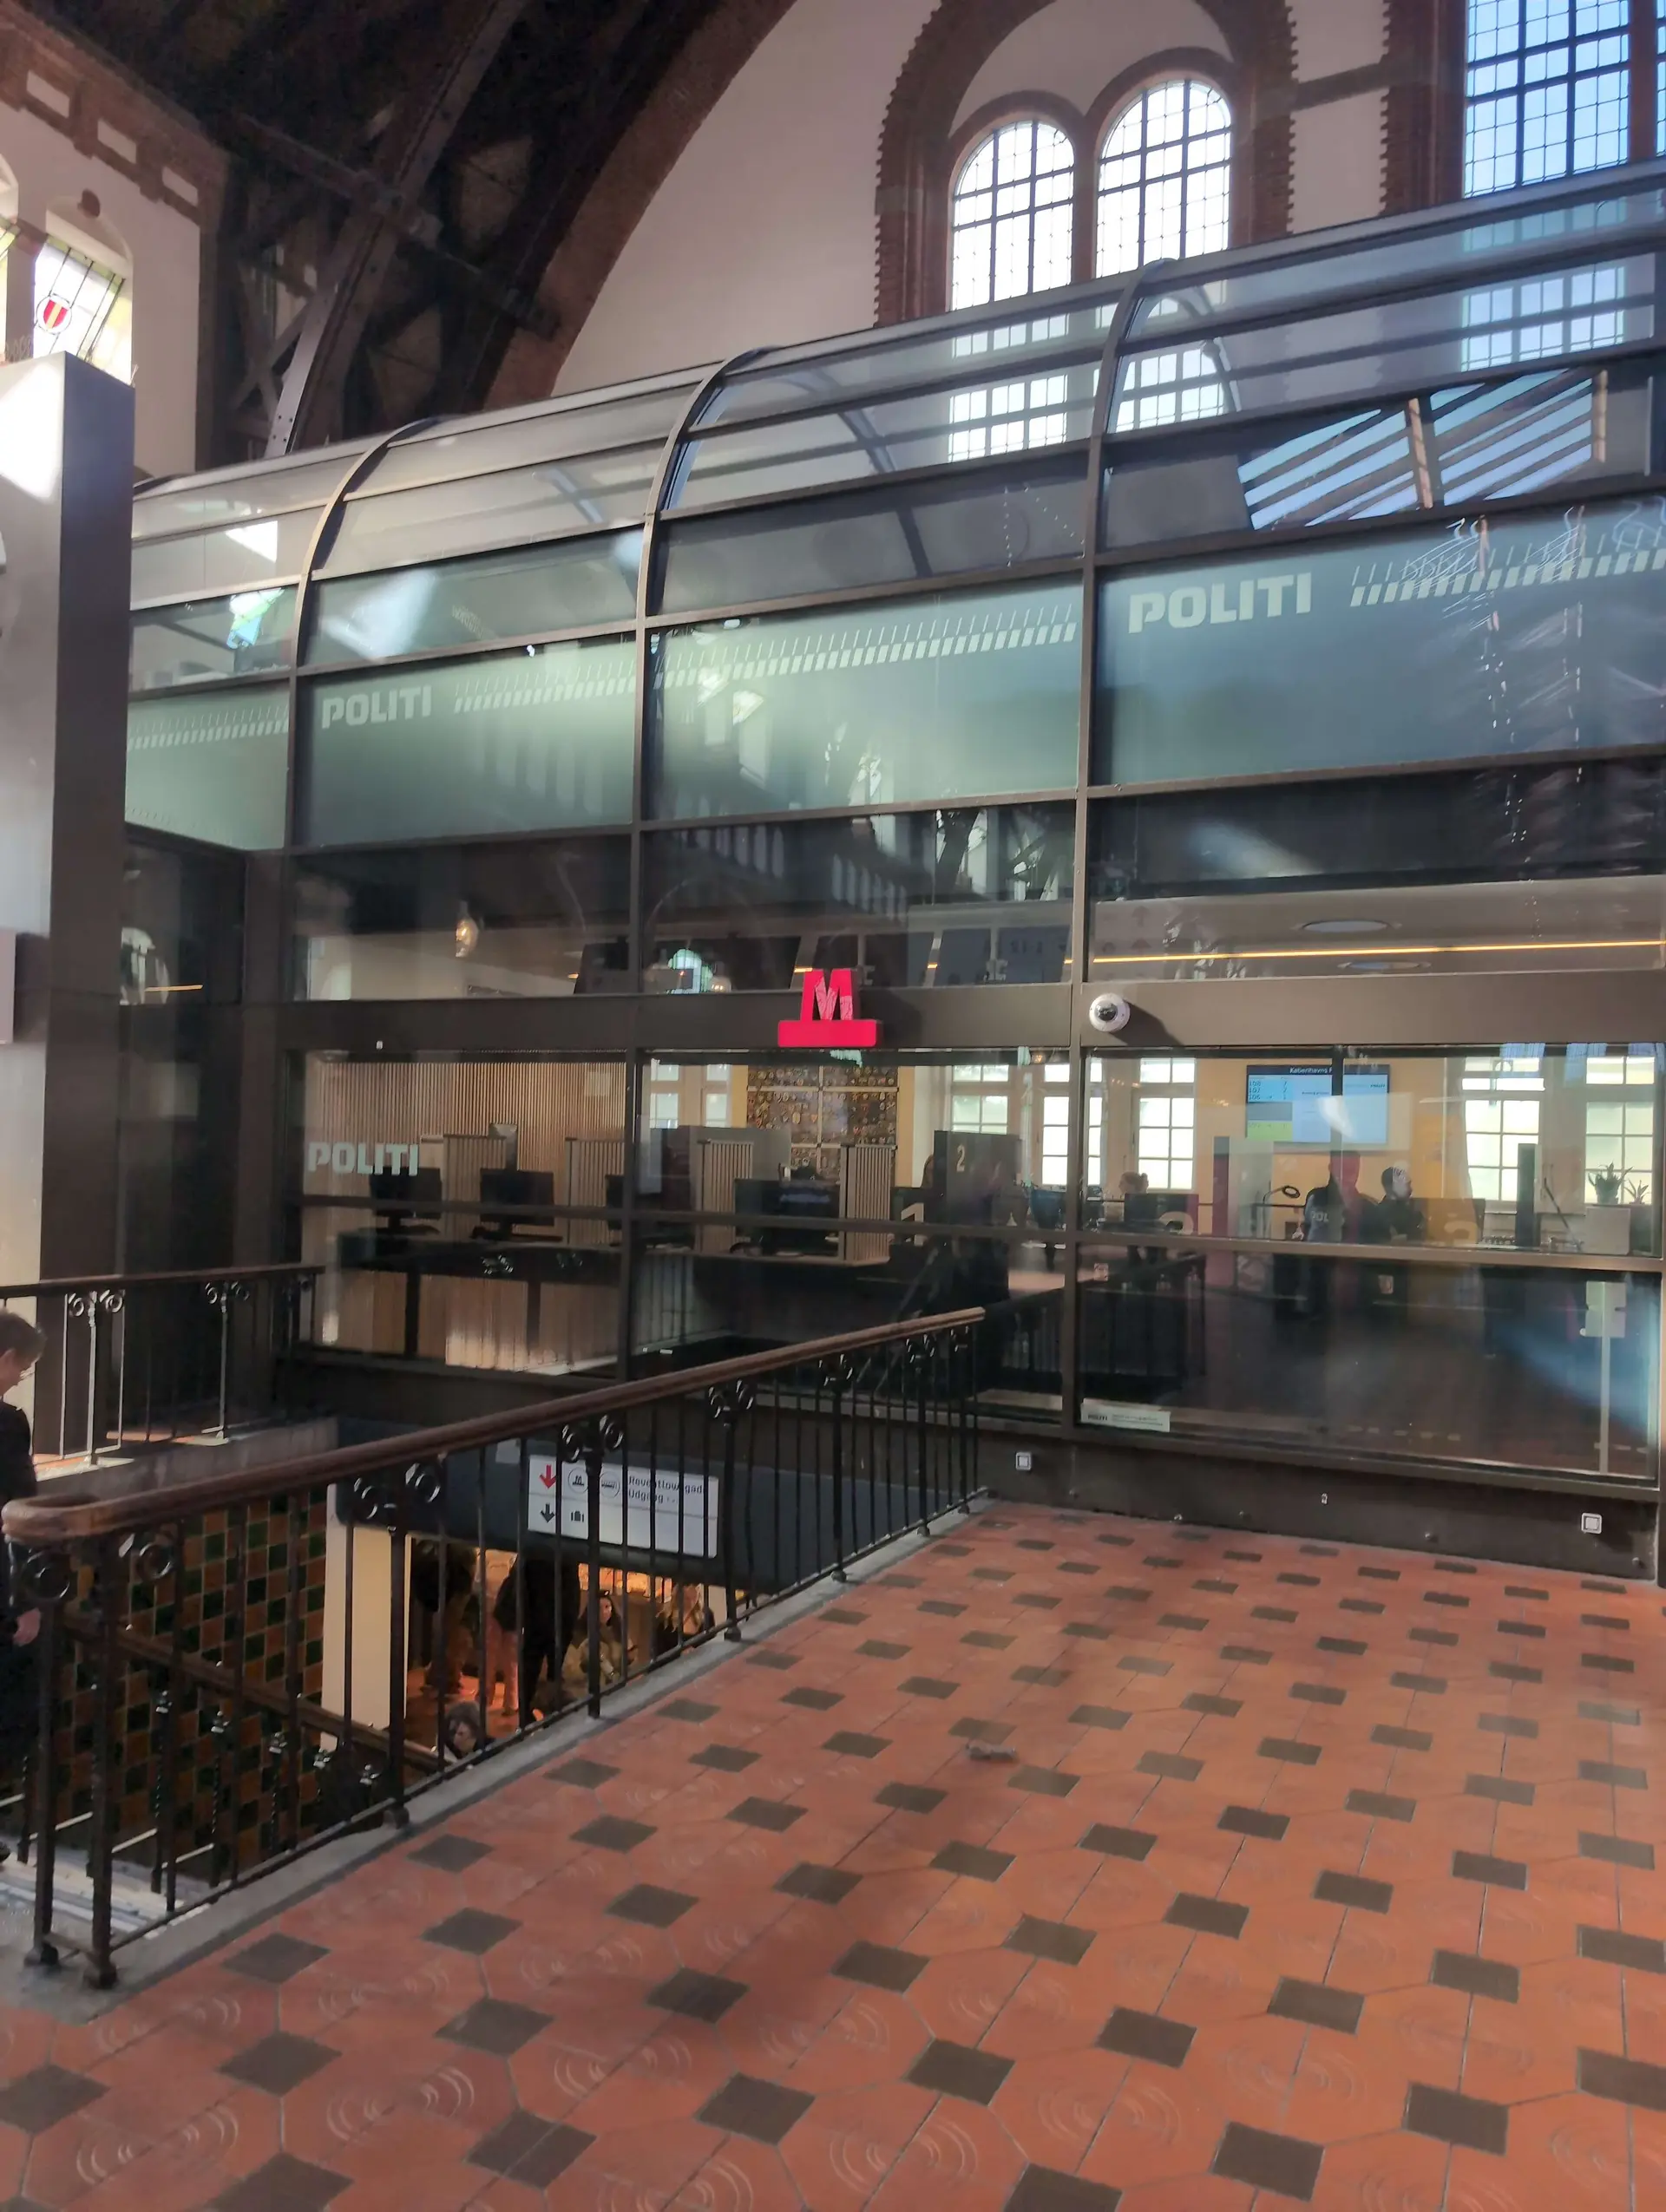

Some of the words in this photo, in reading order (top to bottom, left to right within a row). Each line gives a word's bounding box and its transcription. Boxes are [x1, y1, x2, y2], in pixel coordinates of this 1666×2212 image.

[1128, 572, 1312, 634] POLITI
[322, 684, 432, 729] POLITI
[308, 1142, 418, 1176] POLITI
[956, 1143, 966, 1172] 2
[629, 1488, 664, 1503] Udgg
